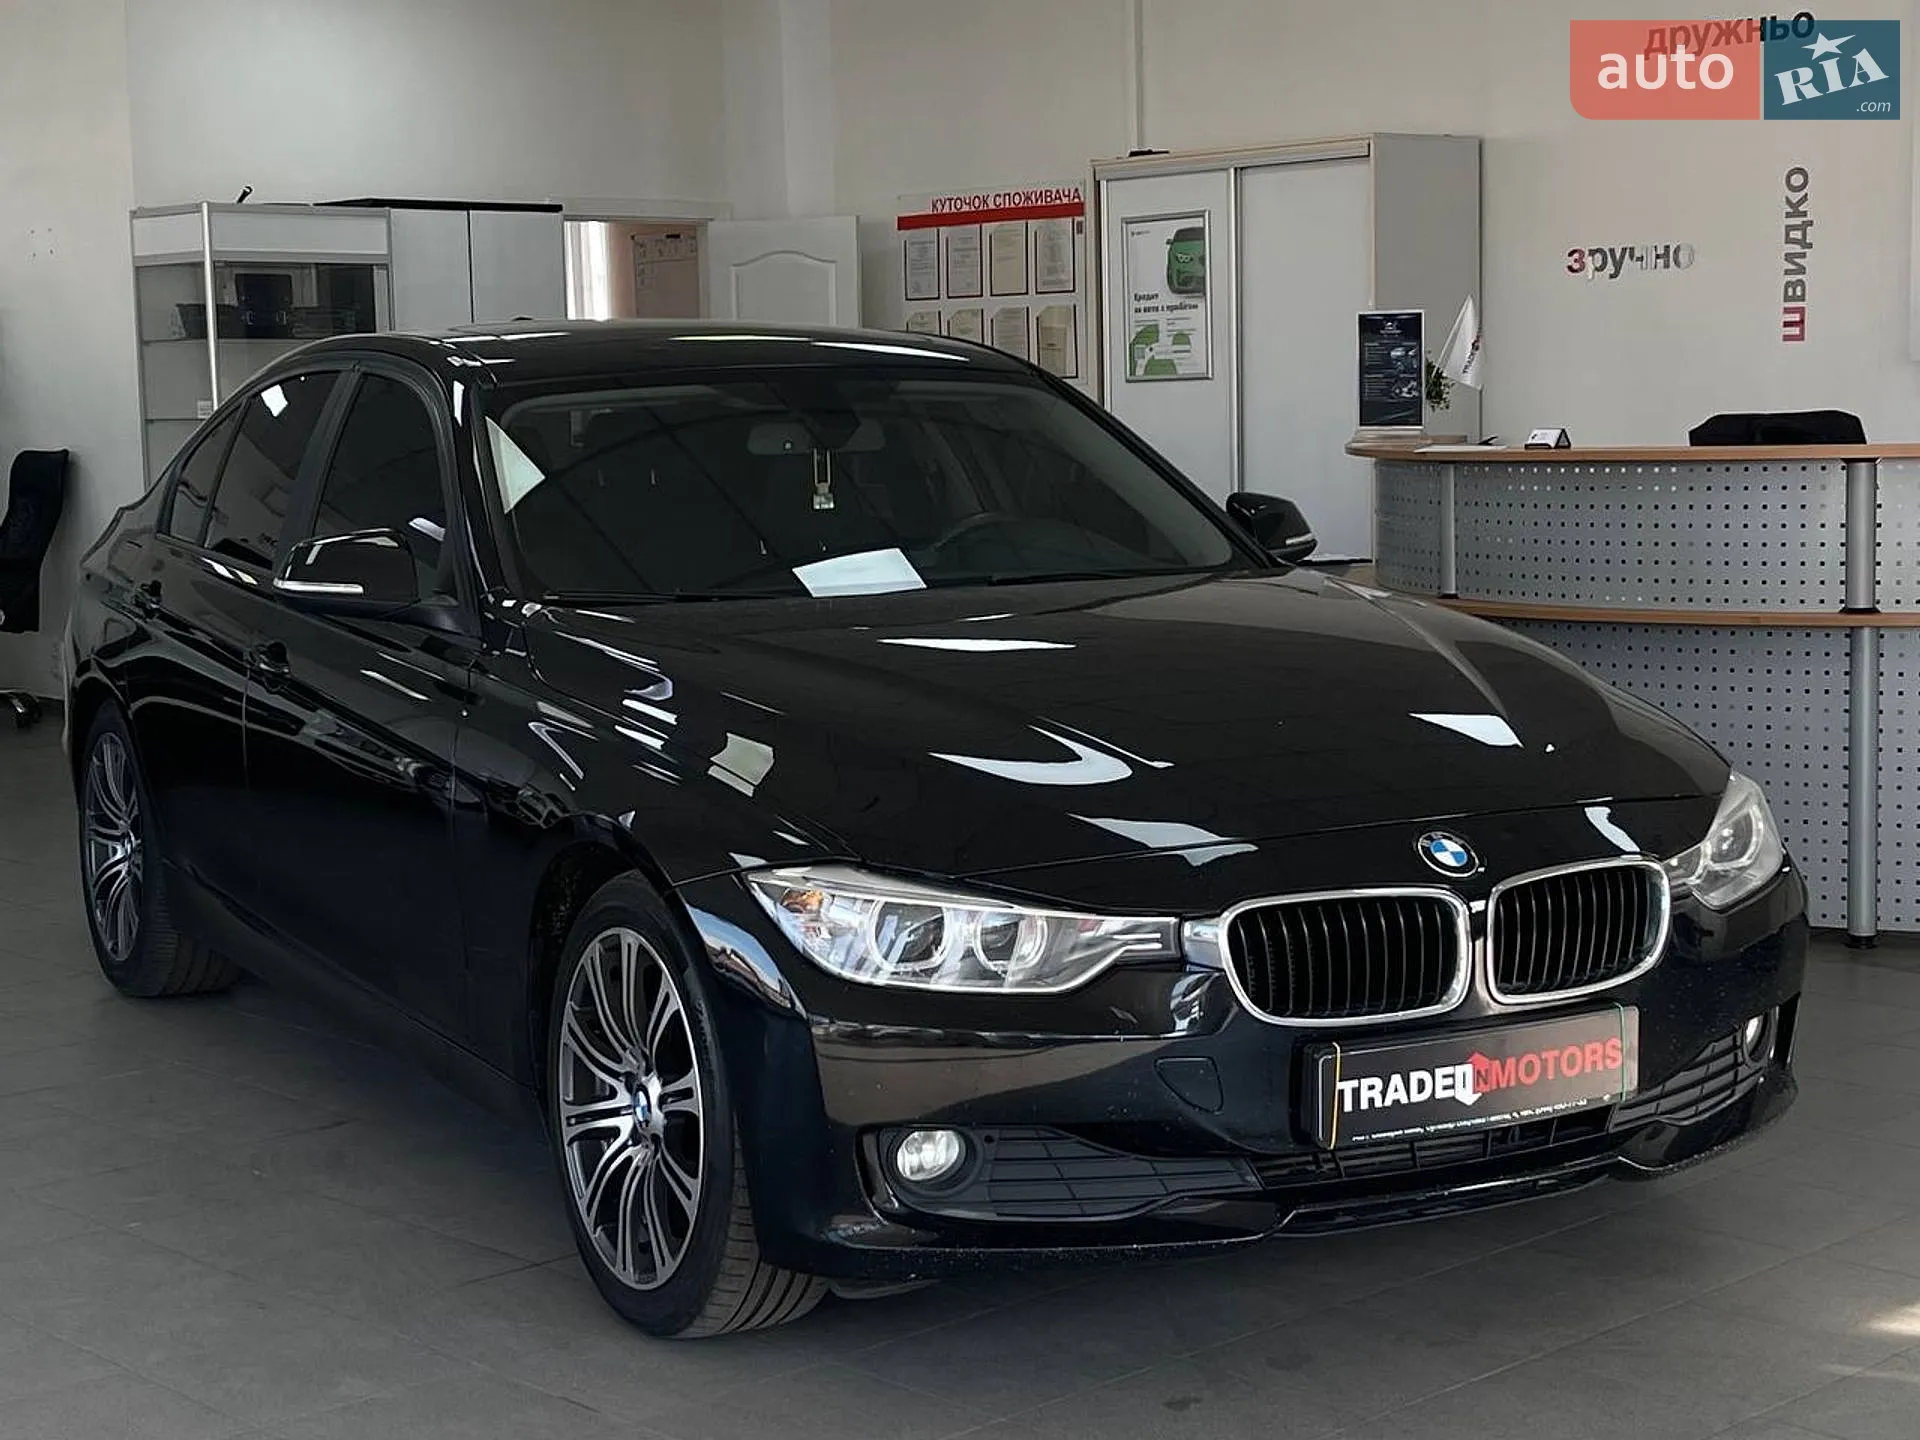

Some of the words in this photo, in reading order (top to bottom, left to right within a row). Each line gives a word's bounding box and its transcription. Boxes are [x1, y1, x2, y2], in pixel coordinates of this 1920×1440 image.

[931, 194, 990, 213] КУТОЧОК
[993, 187, 1082, 209] СПОЖИВАЧА
[1567, 243, 1695, 280] зручно
